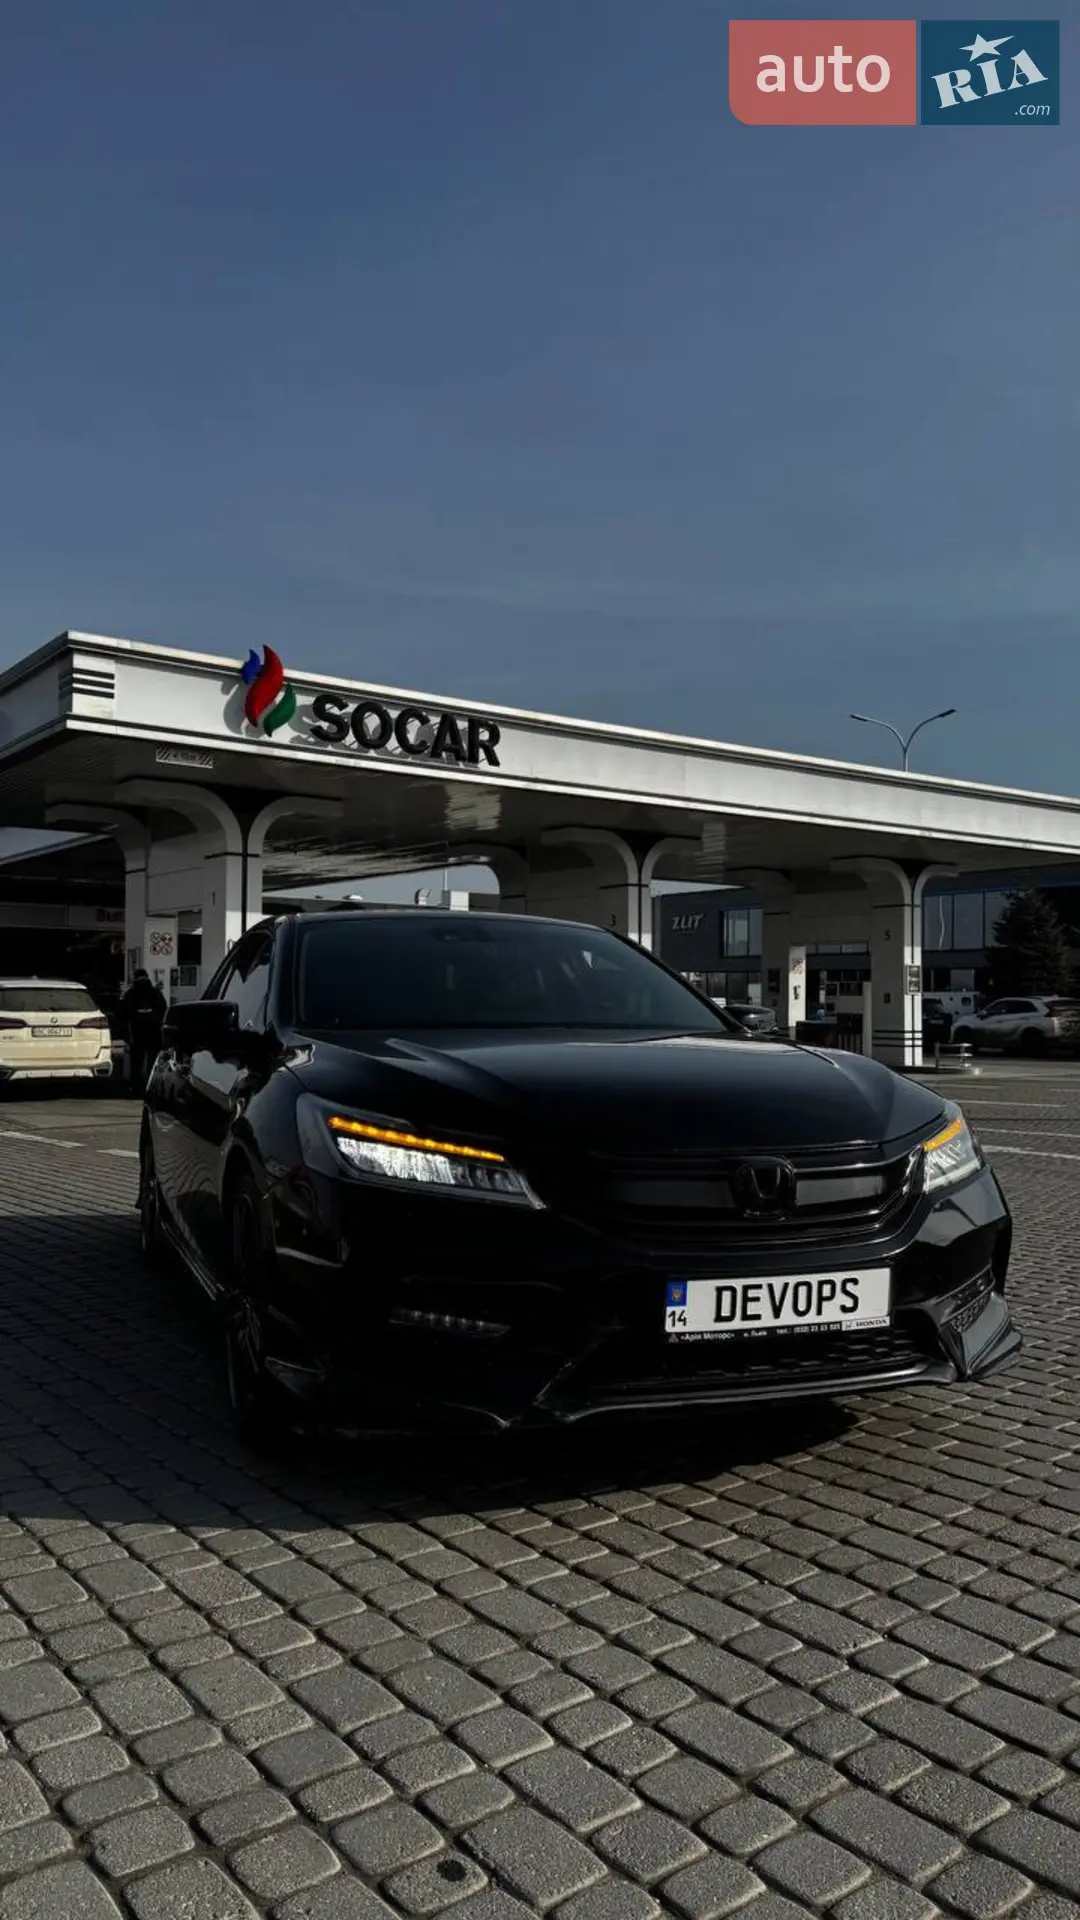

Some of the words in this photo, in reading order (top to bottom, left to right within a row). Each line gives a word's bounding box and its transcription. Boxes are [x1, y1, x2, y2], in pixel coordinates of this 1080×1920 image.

[310, 693, 501, 768] SOCAR
[714, 1277, 860, 1323] DEVOPS
[668, 1310, 687, 1327] 14
[855, 1318, 888, 1327] HONDA
